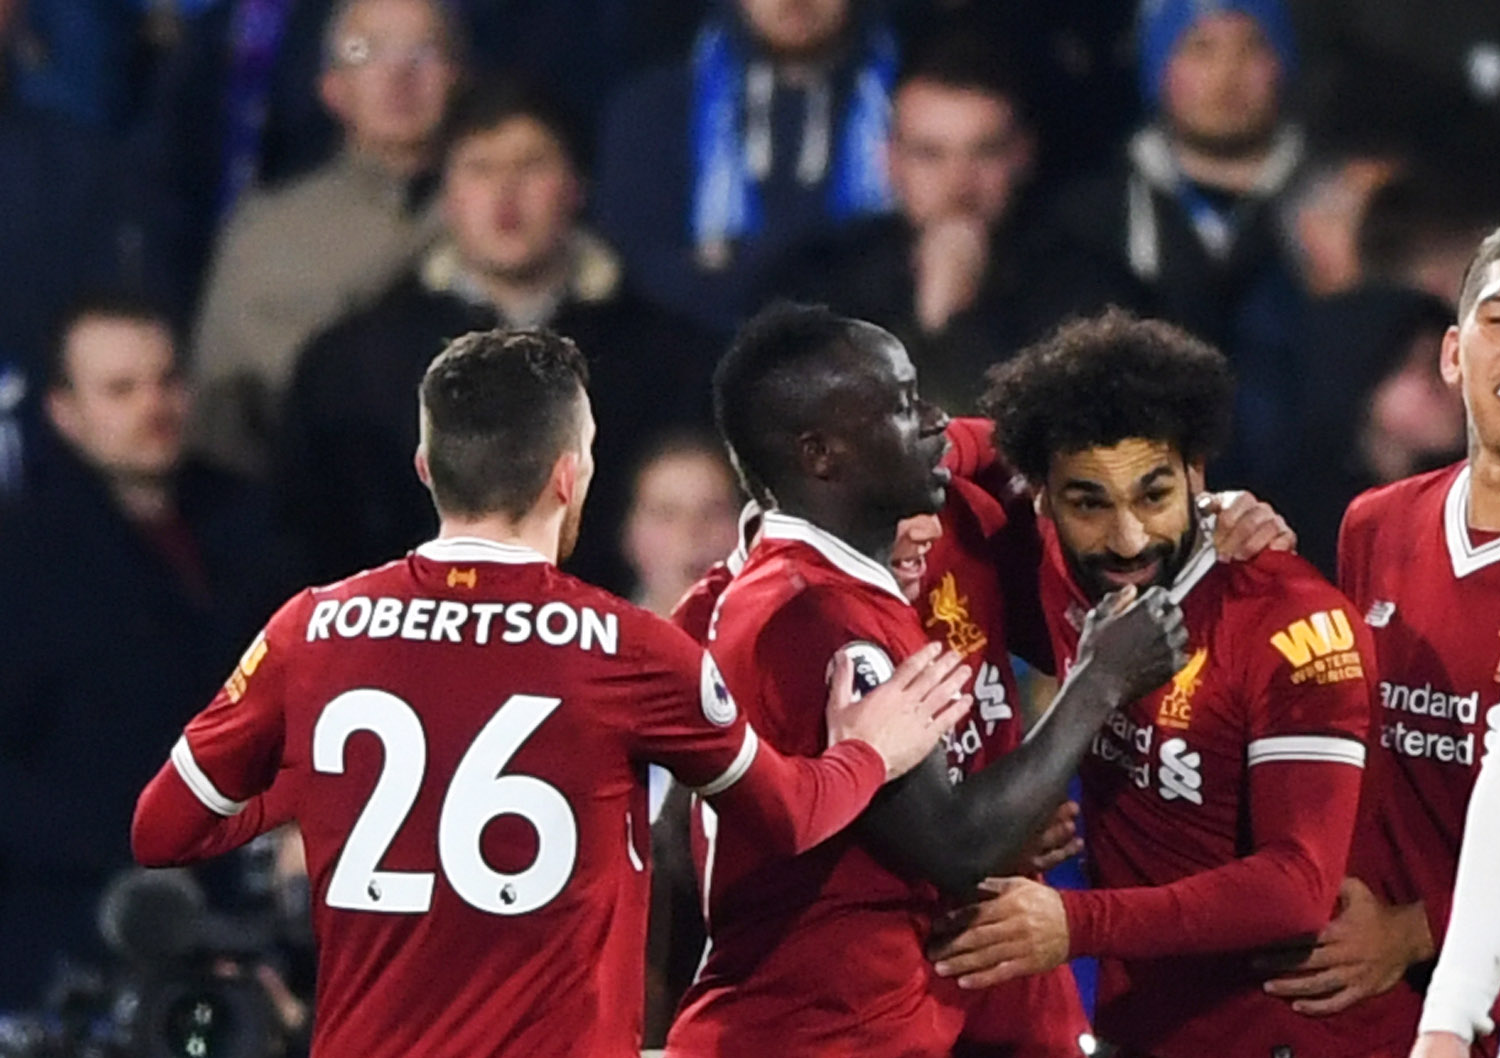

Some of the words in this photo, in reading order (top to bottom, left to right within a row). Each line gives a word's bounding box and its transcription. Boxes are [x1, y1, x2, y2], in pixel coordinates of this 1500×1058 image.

[306, 596, 618, 654] ROBERTSON
[1270, 609, 1355, 668] WU
[1380, 721, 1475, 766] tered
[313, 688, 577, 915] 26
